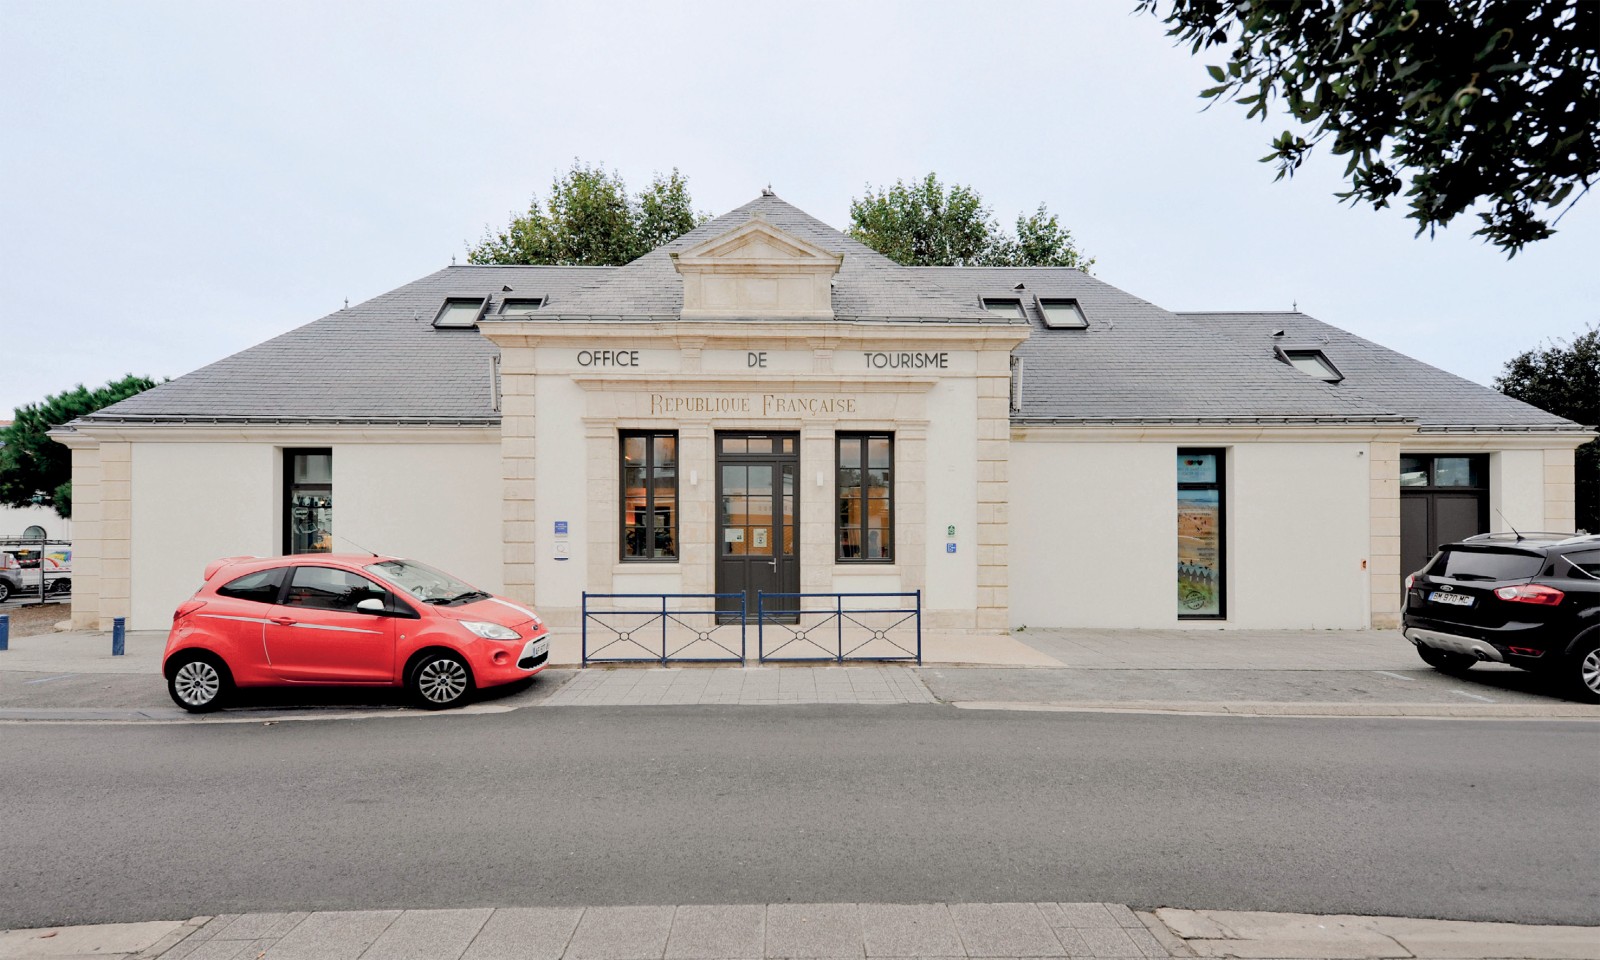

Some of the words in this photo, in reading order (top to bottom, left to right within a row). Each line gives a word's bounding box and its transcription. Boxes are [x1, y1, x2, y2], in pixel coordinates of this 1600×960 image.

[577, 350, 639, 367] OFFICE
[747, 352, 767, 368] DE
[863, 352, 949, 369] TOURISME
